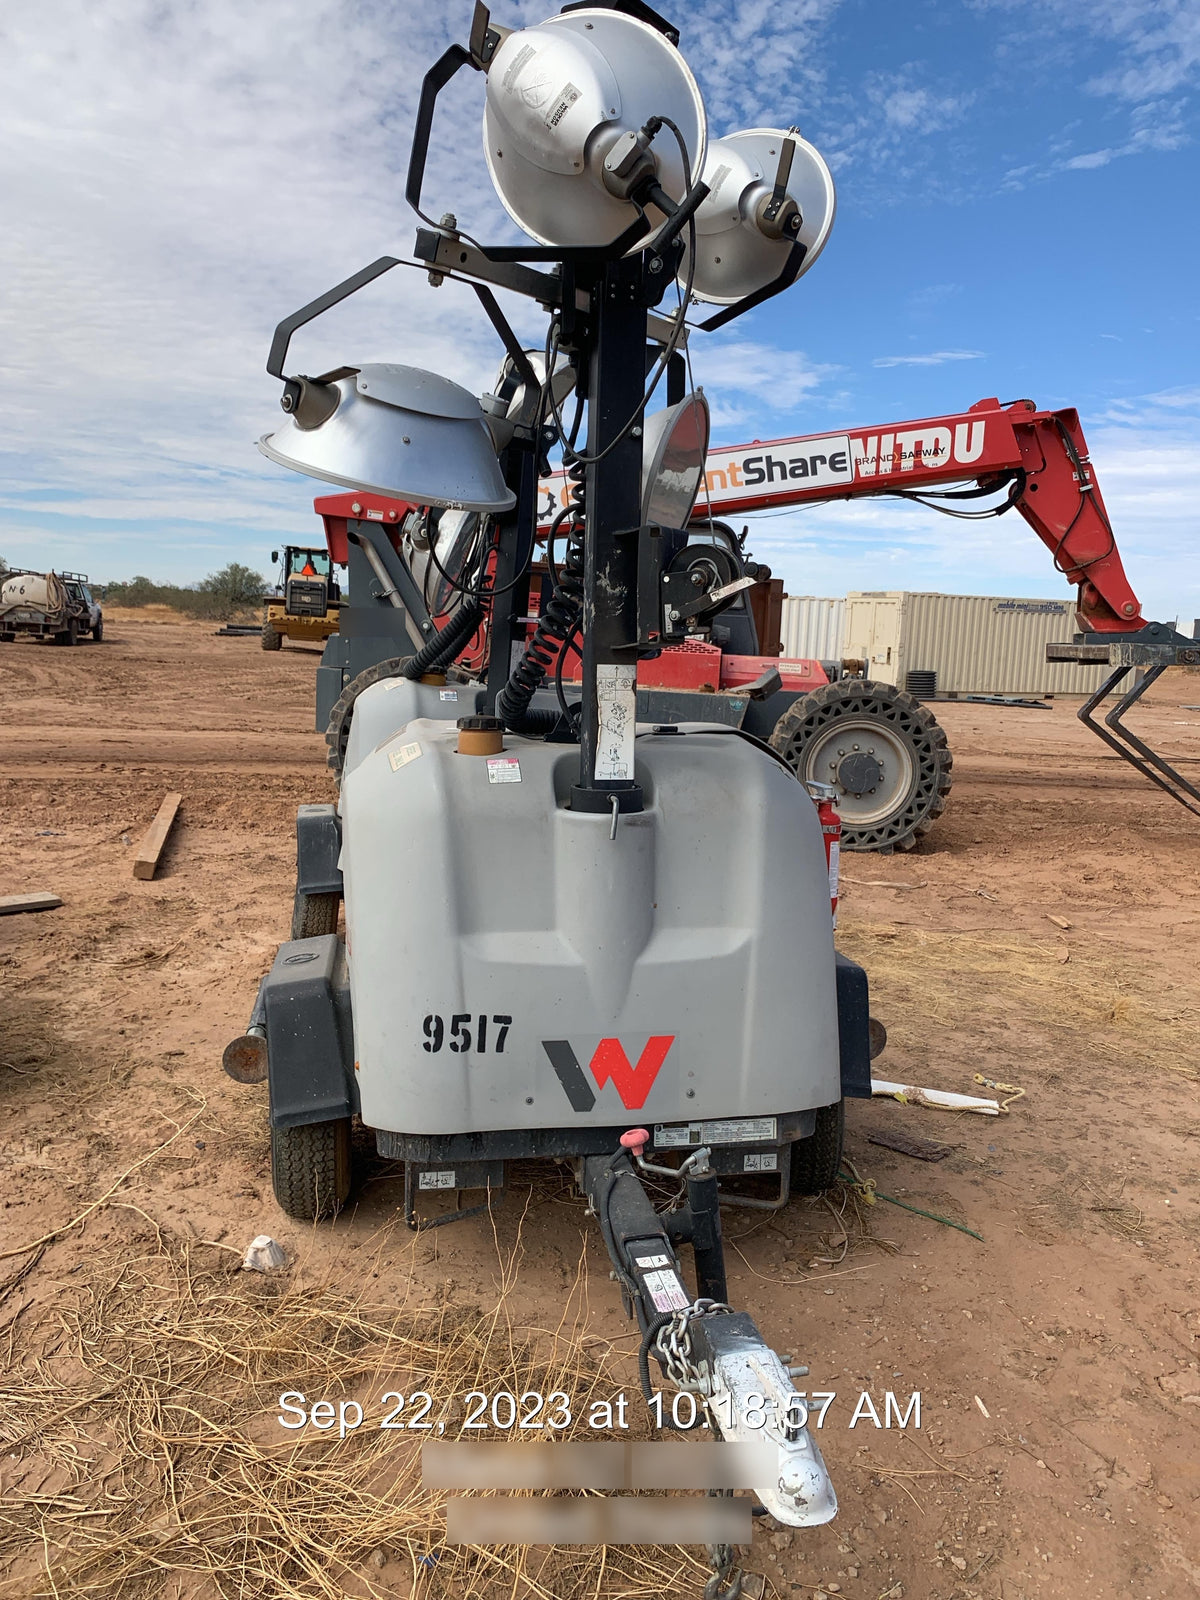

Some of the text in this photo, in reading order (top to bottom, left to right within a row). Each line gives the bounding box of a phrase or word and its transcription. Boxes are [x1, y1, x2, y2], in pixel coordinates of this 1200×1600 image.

[856, 446, 946, 466] BRAND SAFWAY
[422, 1013, 513, 1053] 9517
